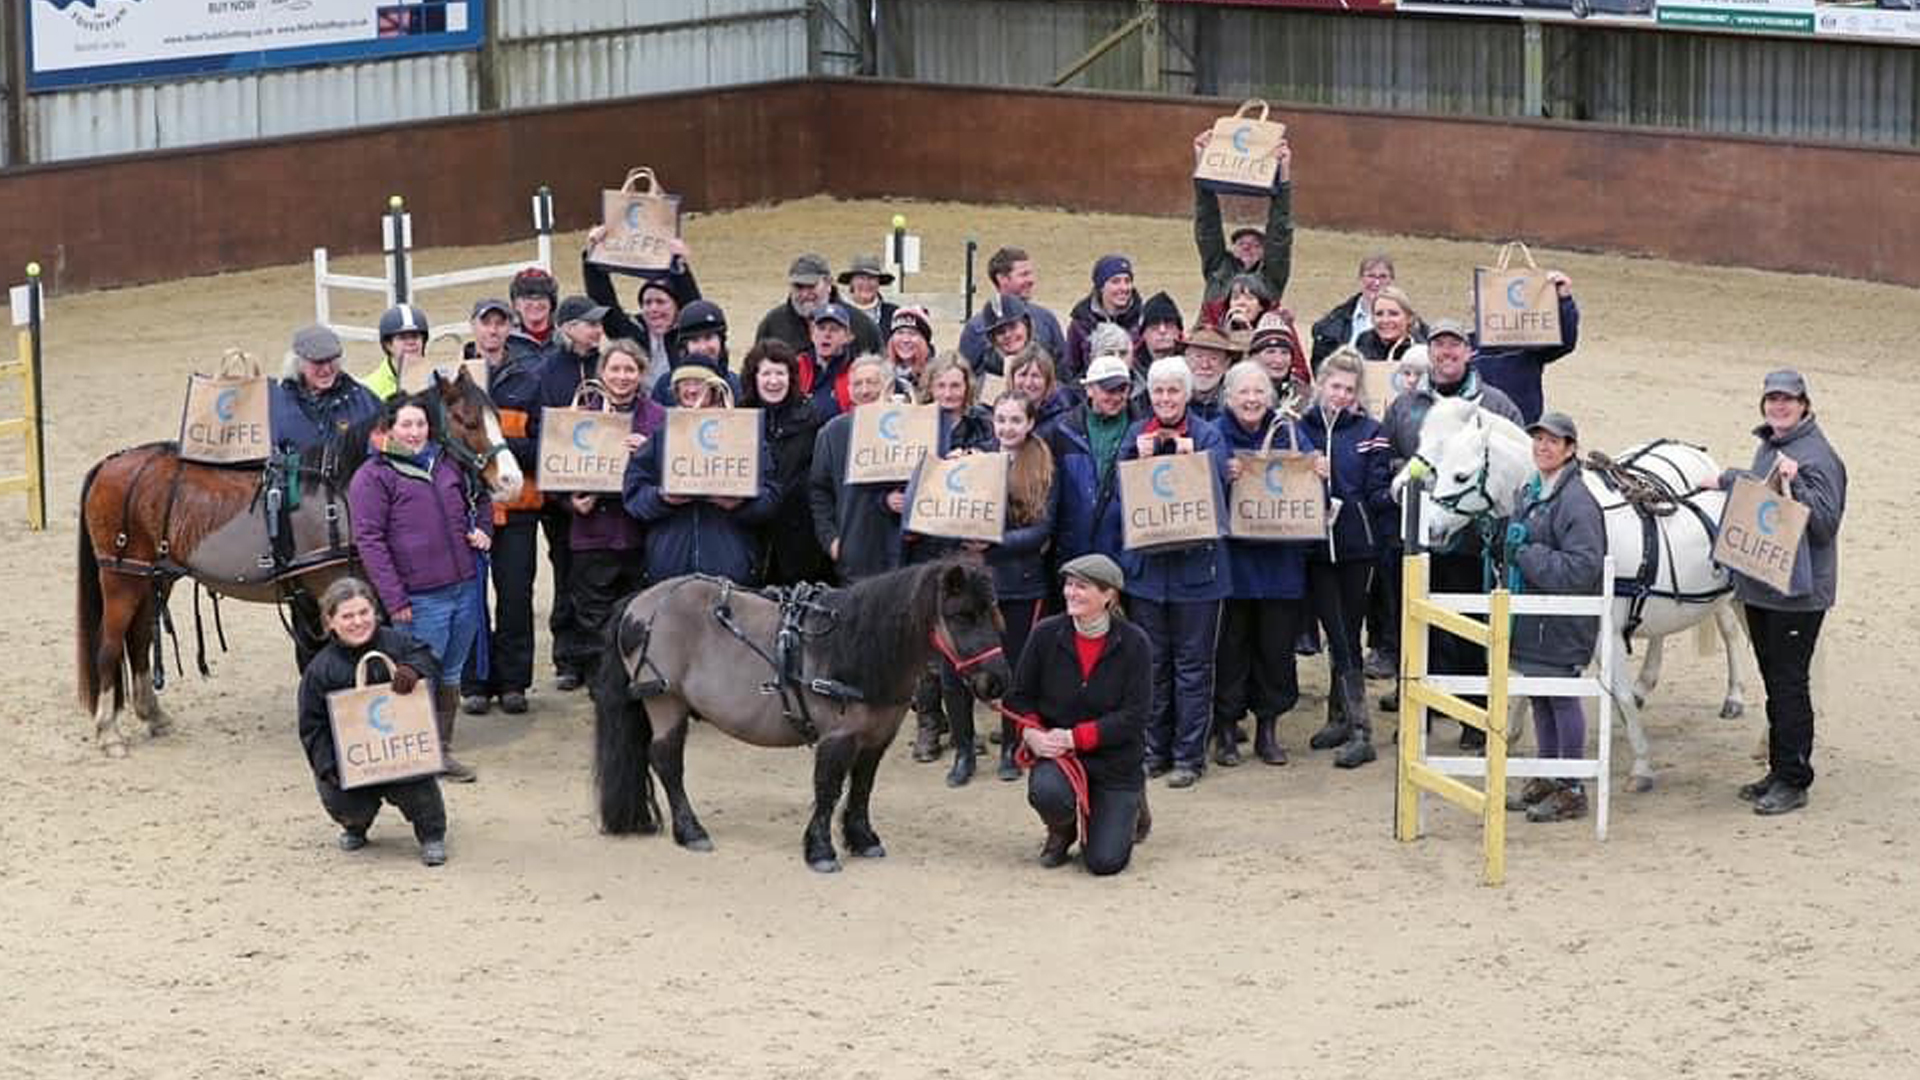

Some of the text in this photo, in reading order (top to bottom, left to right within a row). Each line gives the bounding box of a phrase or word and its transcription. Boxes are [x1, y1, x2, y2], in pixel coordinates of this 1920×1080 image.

[207, 2, 229, 14] BUY
[230, 0, 256, 12] NOW
[1206, 152, 1269, 175] CLIFFE
[605, 233, 668, 256] CLIFFE
[1485, 310, 1556, 330] CLIFFE
[188, 422, 262, 445] CLIFFE
[544, 453, 621, 475] CLIFFE
[671, 456, 750, 478] CLIFFE
[917, 498, 997, 522] CLIFFE
[1132, 500, 1209, 529] CLIFFE
[1238, 499, 1315, 520] CLIFFE
[1725, 525, 1792, 572] CLIFFE
[347, 731, 430, 766] CLIFFE
